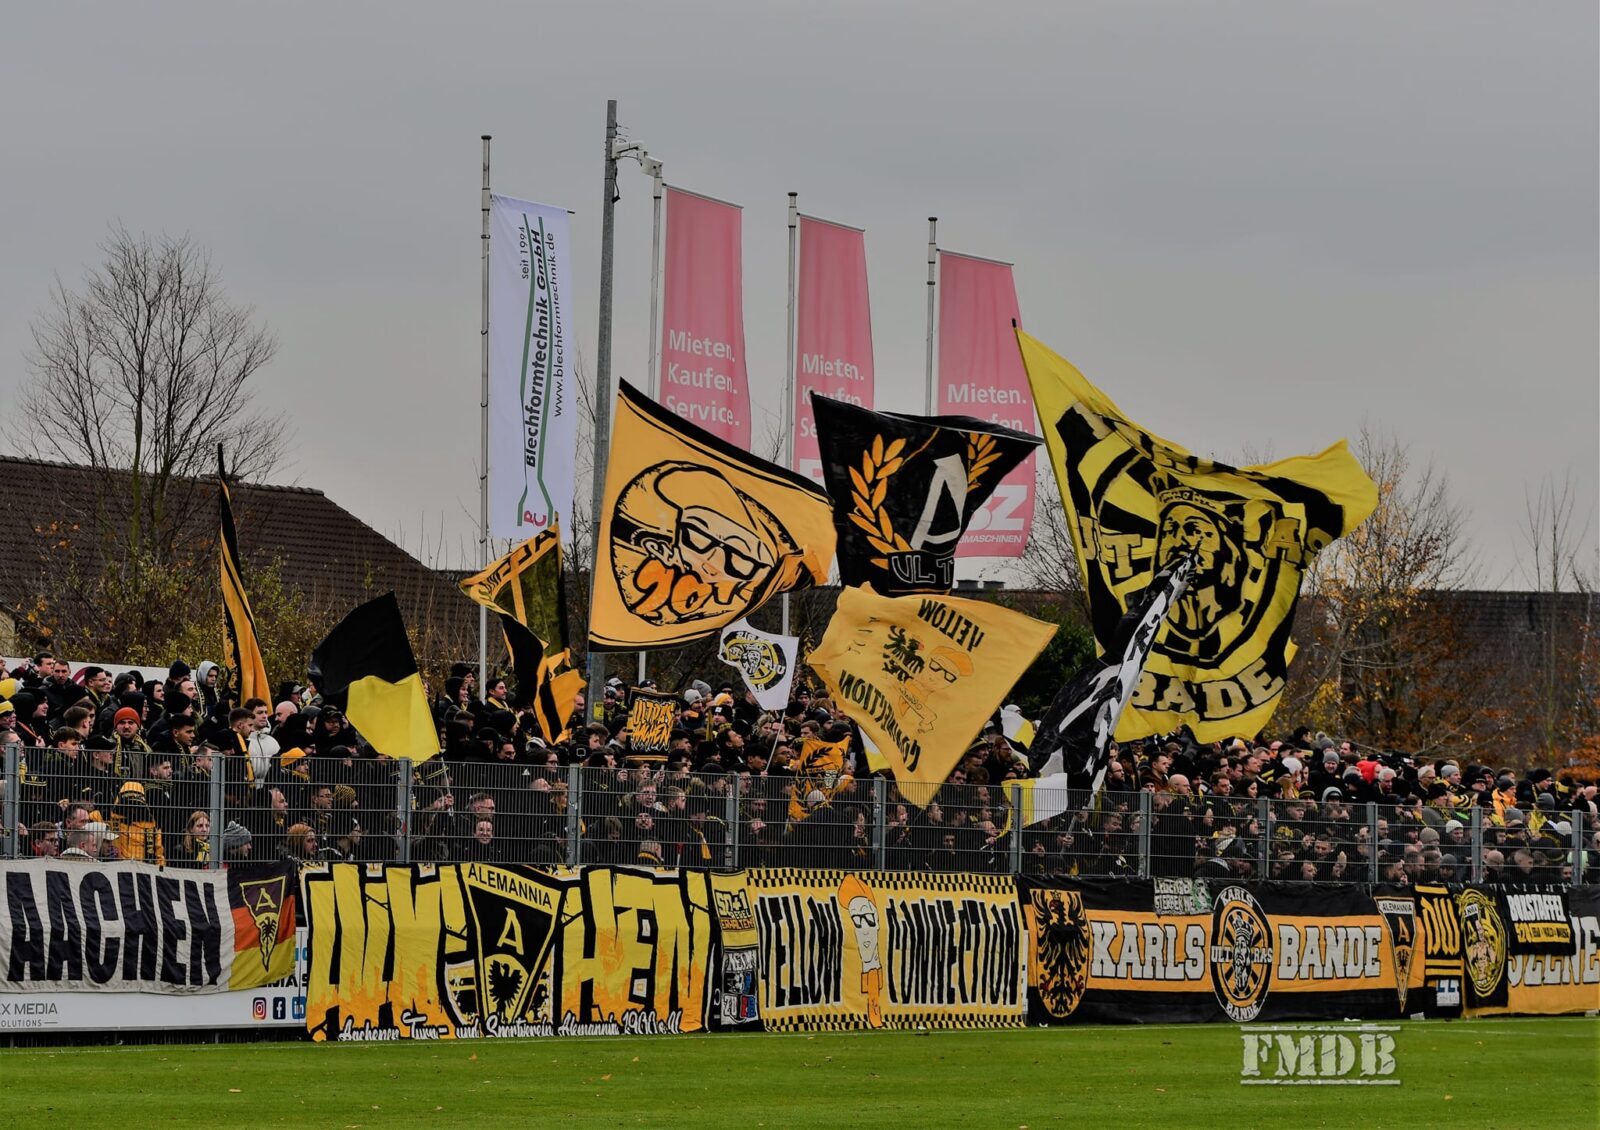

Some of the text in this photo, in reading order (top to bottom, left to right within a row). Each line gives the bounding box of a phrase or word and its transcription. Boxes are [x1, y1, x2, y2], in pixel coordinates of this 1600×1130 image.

[518, 226, 529, 280] seit 1994
[544, 232, 564, 418] www.blechformtechnik.de
[524, 229, 549, 468] Blechformtechnik GmbH
[669, 329, 735, 362] Mieten.
[667, 361, 738, 394] Kaufen.
[802, 353, 864, 381] Mieten.
[666, 395, 740, 426] Service.
[947, 383, 1027, 405] Mieten.
[467, 862, 554, 910] ALEMANNIA
[1220, 886, 1255, 908] KARLS
[6, 870, 222, 985] AACHEN
[497, 907, 524, 956] A
[1090, 920, 1206, 980] KARLS
[1278, 924, 1383, 980] BANDE
[14, 1002, 58, 1016] MEDIA
[1226, 1000, 1261, 1021] BANDE
